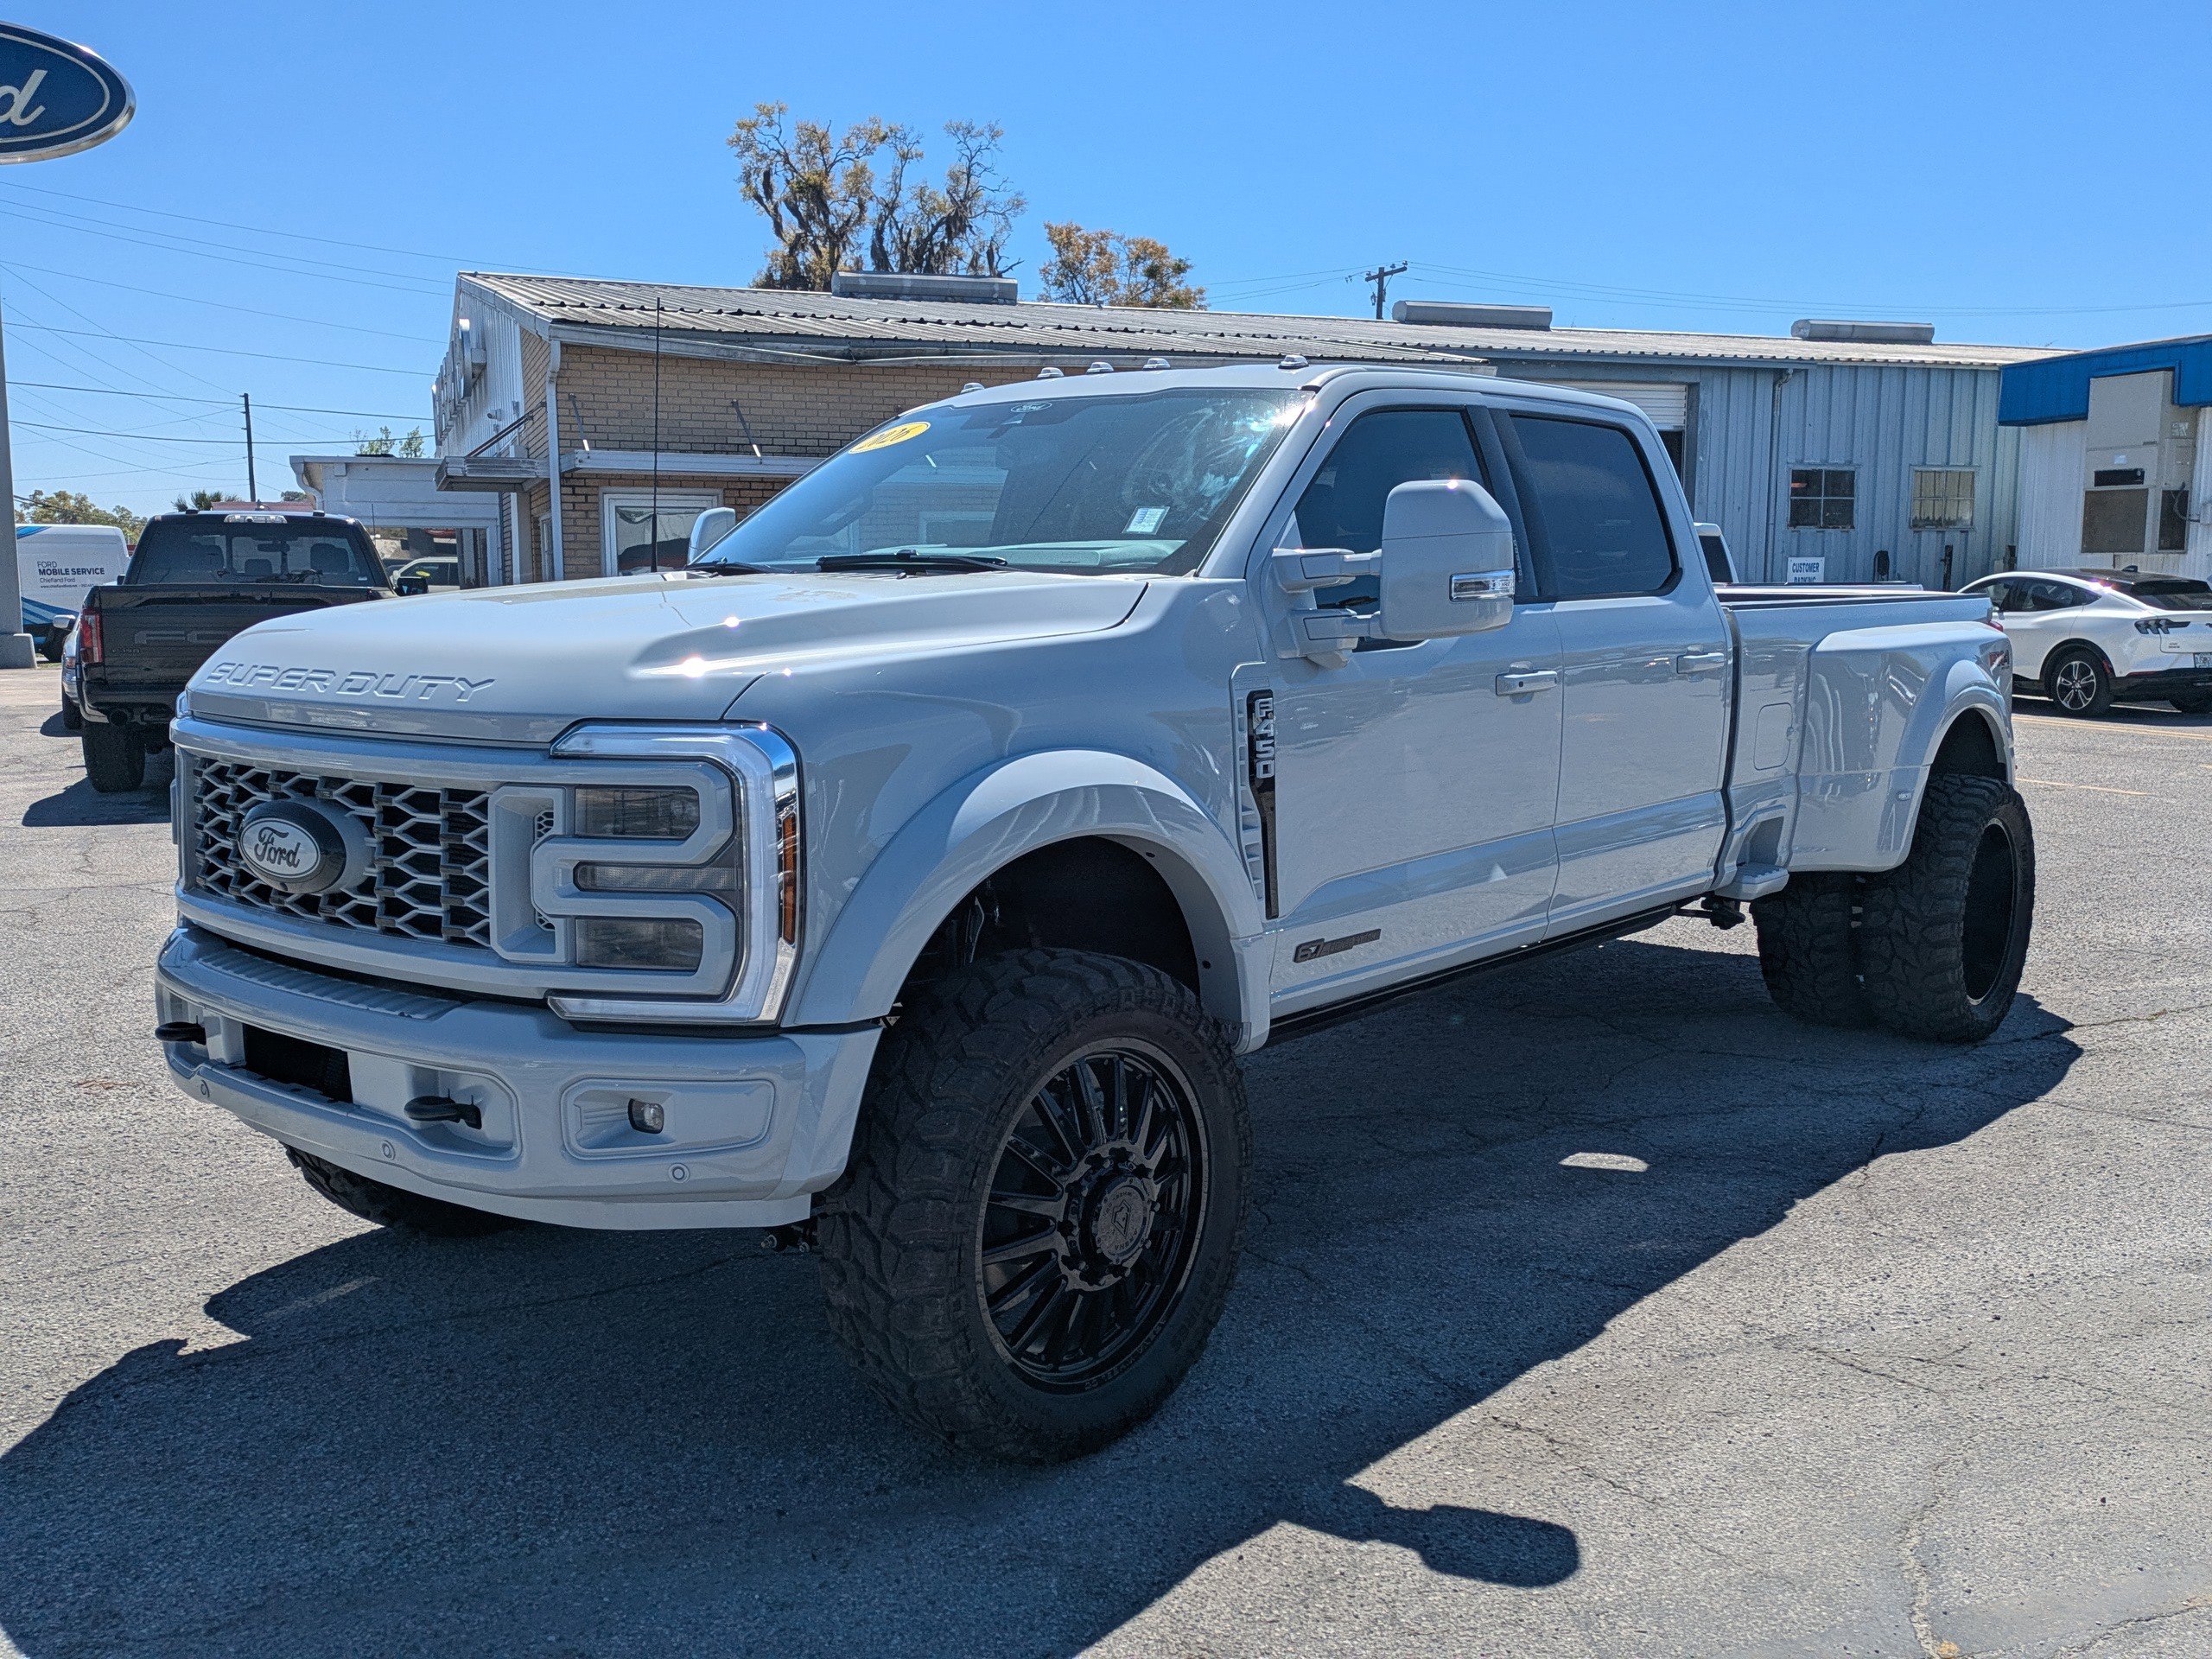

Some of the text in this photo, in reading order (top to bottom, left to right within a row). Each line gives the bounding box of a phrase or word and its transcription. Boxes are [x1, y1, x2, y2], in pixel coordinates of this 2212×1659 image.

[71, 567, 105, 575] SERVICE
[1792, 563, 1819, 573] CUSTOMER
[206, 662, 496, 702] SUPER DUTY
[254, 826, 301, 868] Ford
